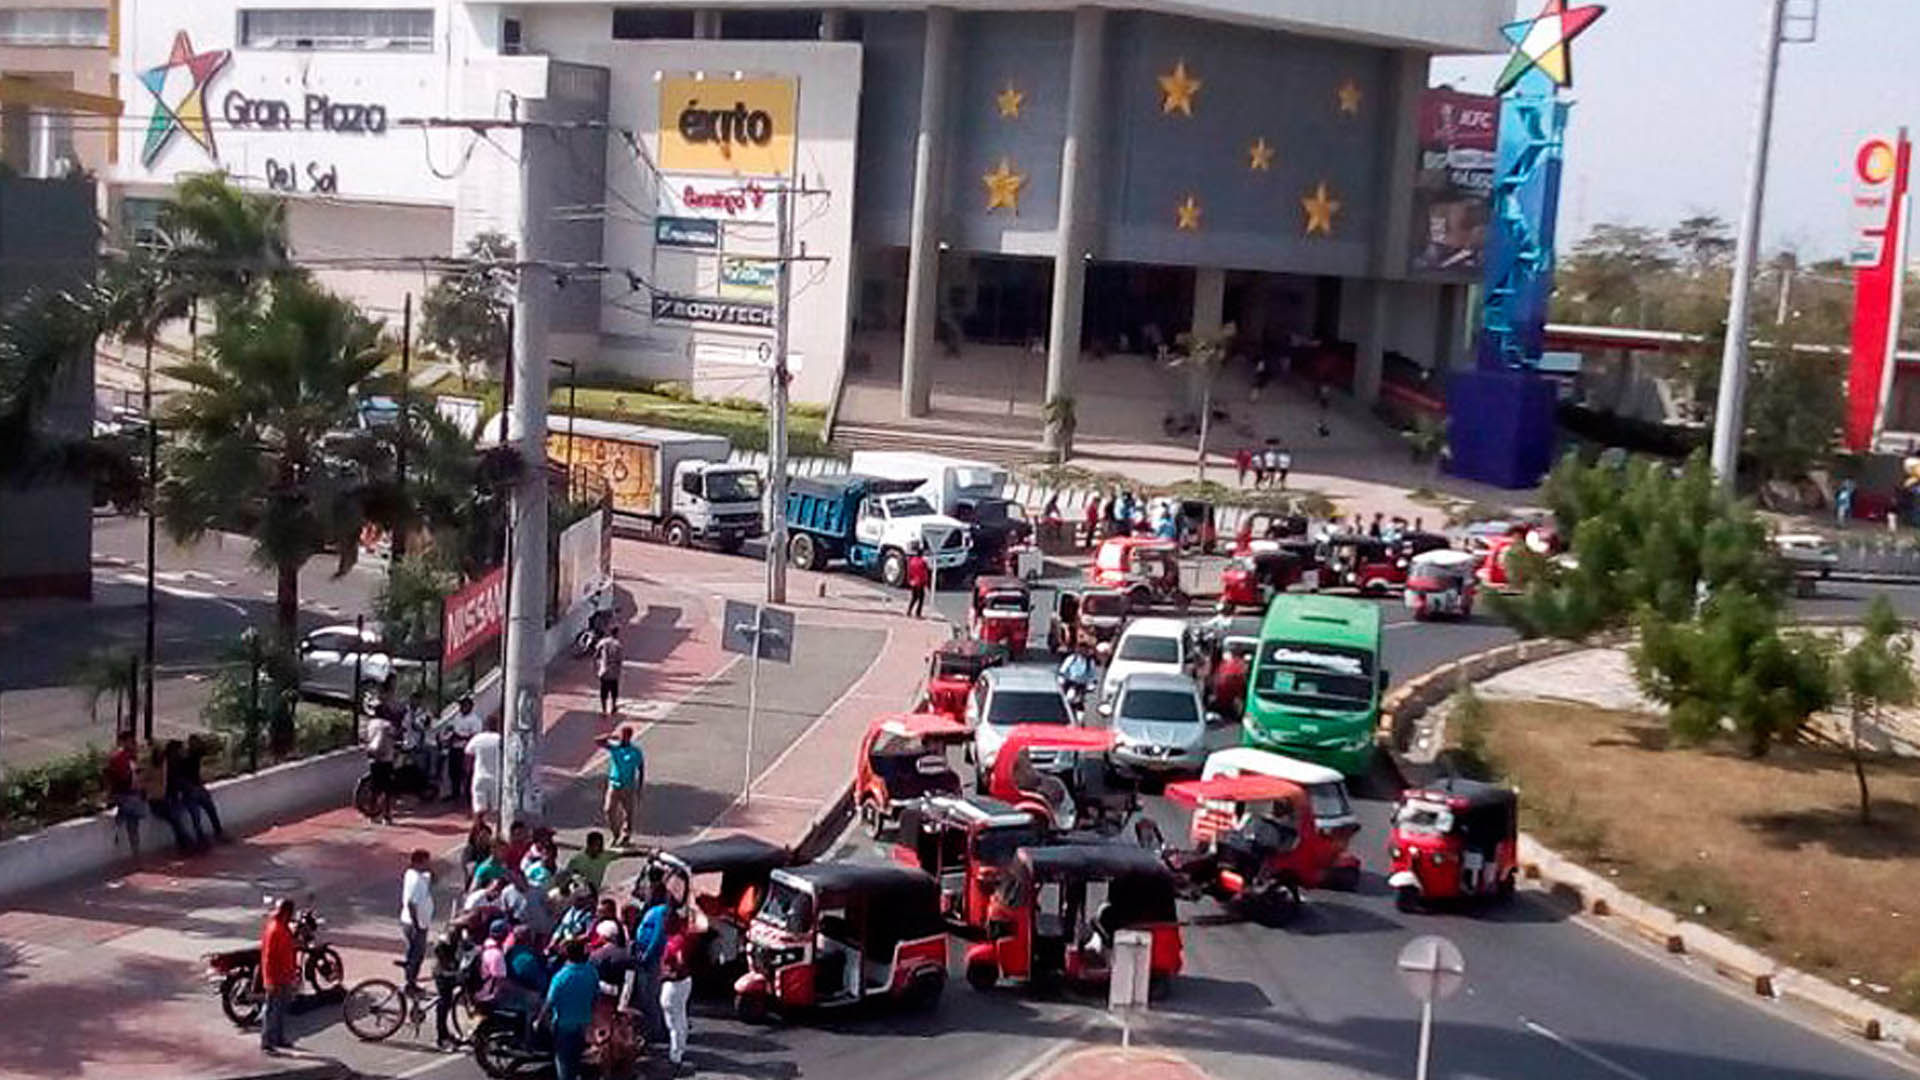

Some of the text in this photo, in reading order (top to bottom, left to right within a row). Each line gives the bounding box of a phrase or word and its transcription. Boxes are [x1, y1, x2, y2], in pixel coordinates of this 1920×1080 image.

[224, 90, 387, 134] Gran Plaza
[678, 99, 774, 154] éxito
[265, 158, 339, 195] Del Sol
[446, 580, 507, 656] NISSAN
